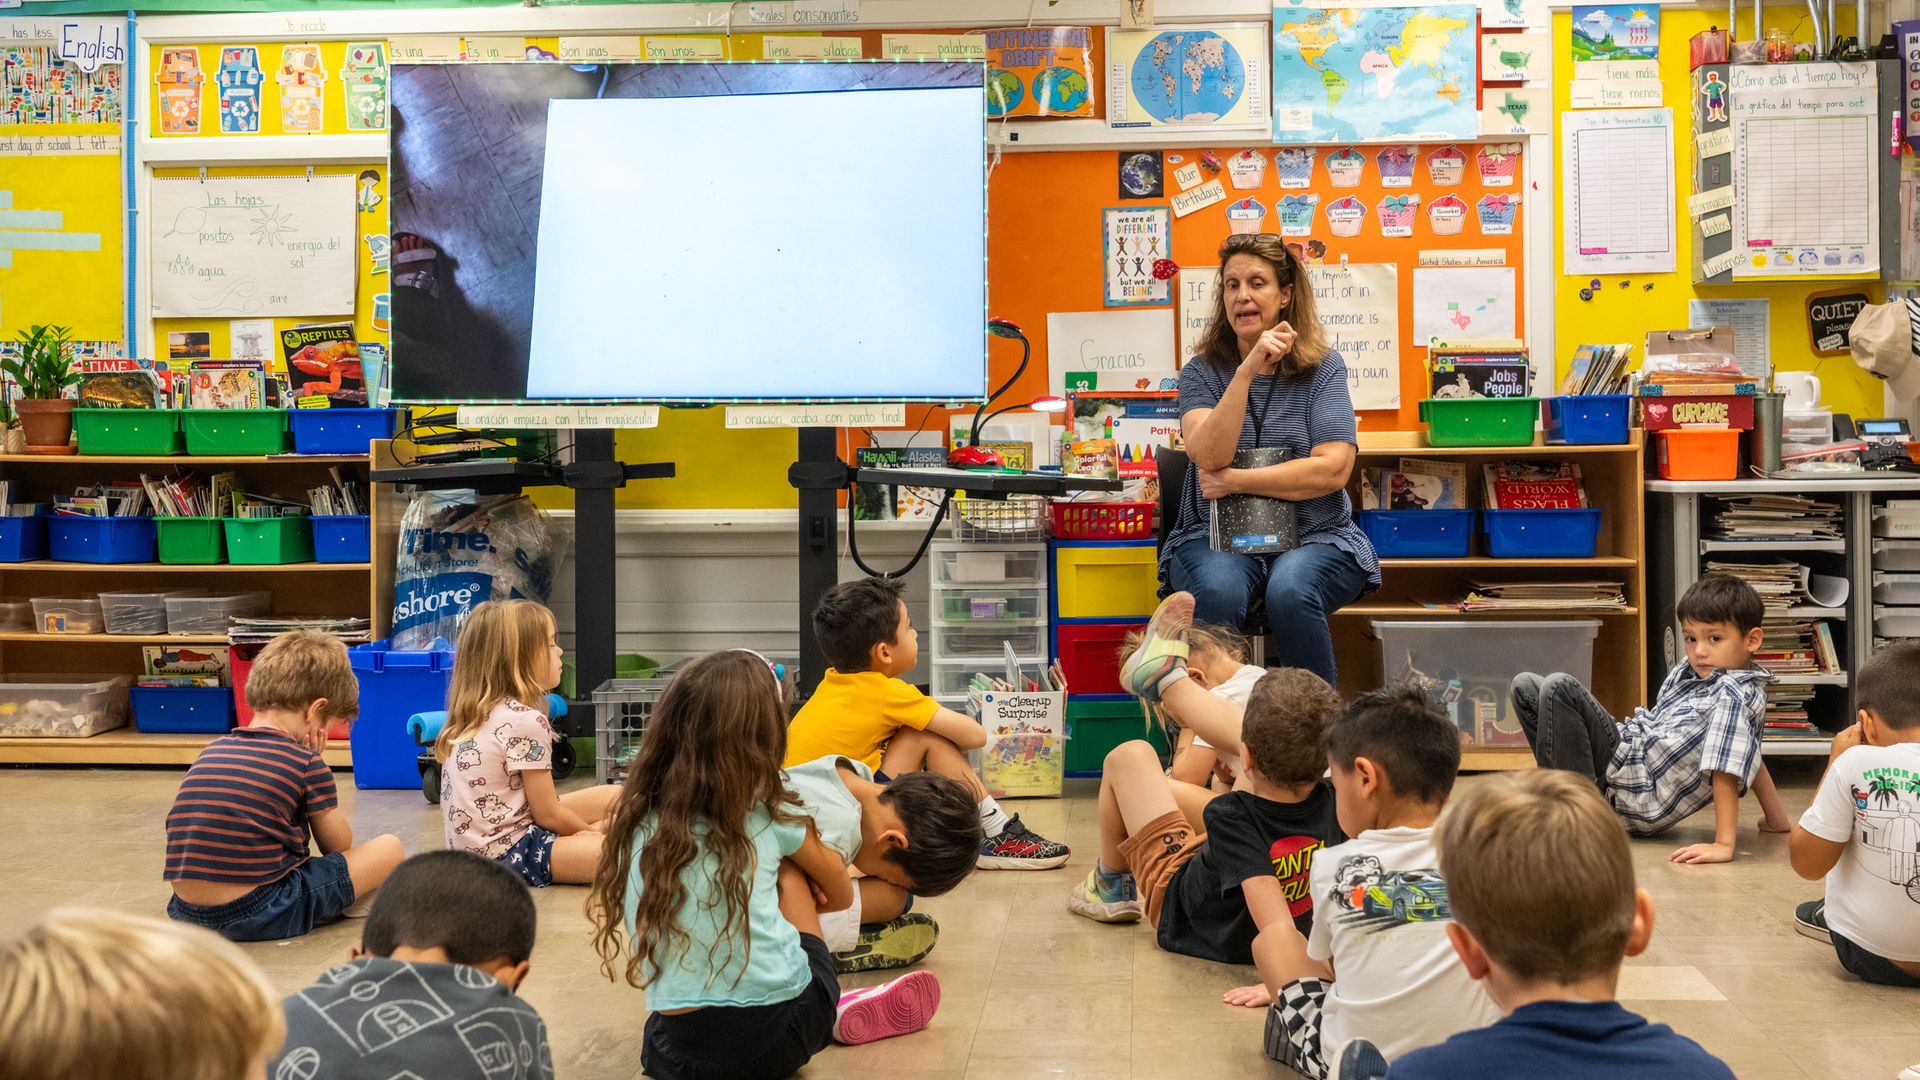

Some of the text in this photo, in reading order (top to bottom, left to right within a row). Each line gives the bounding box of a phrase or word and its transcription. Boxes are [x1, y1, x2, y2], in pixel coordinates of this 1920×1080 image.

[751, 1, 859, 22] ocales consonantes
[12, 23, 54, 38] has less.
[62, 24, 124, 71] English
[389, 40, 424, 58] Es una
[466, 40, 499, 58] Es un
[560, 42, 609, 58] Son unas
[647, 41, 695, 58] Son unos
[765, 40, 791, 57] Tiene
[884, 38, 983, 58] Tiene palabras.
[1002, 49, 1055, 67] DRIFT
[1502, 72, 1524, 80] country
[1607, 65, 1630, 79] tiene
[1769, 68, 1787, 86] está
[1792, 66, 1800, 83] el
[1805, 66, 1837, 87] tiempo
[1840, 63, 1869, 85] hoy?
[1601, 84, 1623, 99] tiene
[1734, 95, 1865, 114] La gráfica del tiempo para oct
[18, 136, 32, 155] day
[35, 136, 43, 150] of
[48, 136, 71, 150] school
[76, 136, 84, 150] I
[1177, 169, 1197, 185] Our
[207, 191, 264, 209] Las hojas
[1174, 184, 1223, 211] Birthdays
[1118, 214, 1155, 224] we are all
[1117, 224, 1157, 234] DIFFERENT
[328, 238, 341, 251] del
[290, 255, 304, 269] sol
[1420, 258, 1439, 266] United
[1441, 258, 1462, 266] States
[1476, 257, 1504, 265] America
[1703, 253, 1748, 278] Tuvimos
[198, 268, 225, 282] agua
[1120, 278, 1132, 286] but
[1123, 286, 1152, 297] BELONG
[1187, 281, 1206, 301] If
[1341, 284, 1354, 297] or
[1359, 281, 1370, 297] in
[269, 294, 288, 304] aire
[1320, 312, 1364, 325] someone
[1369, 311, 1379, 324] is
[1811, 300, 1866, 321] QUIET
[301, 329, 350, 343] REPTILES
[1826, 322, 1851, 335] pleas
[1332, 332, 1392, 359] danger, or
[1080, 338, 1145, 371] Gracias
[90, 361, 127, 371] TIME
[1363, 367, 1388, 379] own
[1490, 370, 1517, 382] Jobs
[1484, 382, 1522, 397] People
[458, 410, 470, 425] La
[475, 412, 508, 425] oración
[513, 413, 548, 429] empieza
[555, 414, 570, 425] con
[577, 409, 597, 425] letra
[727, 407, 904, 428] La oración acaba con punto final.
[1672, 402, 1729, 424] CUPCAKE
[1151, 426, 1181, 435] Patter
[863, 451, 897, 463] Hawaii
[908, 451, 941, 463] Alaska
[1074, 454, 1106, 464] Colorful
[1507, 485, 1569, 494] WORLD
[1513, 500, 1569, 510] FLAGS
[406, 528, 496, 555] Time.
[396, 558, 478, 577] ick Up Store!
[1009, 696, 1051, 709] Cleanup
[998, 706, 1047, 720] Surprise
[1282, 879, 1311, 903] RU
